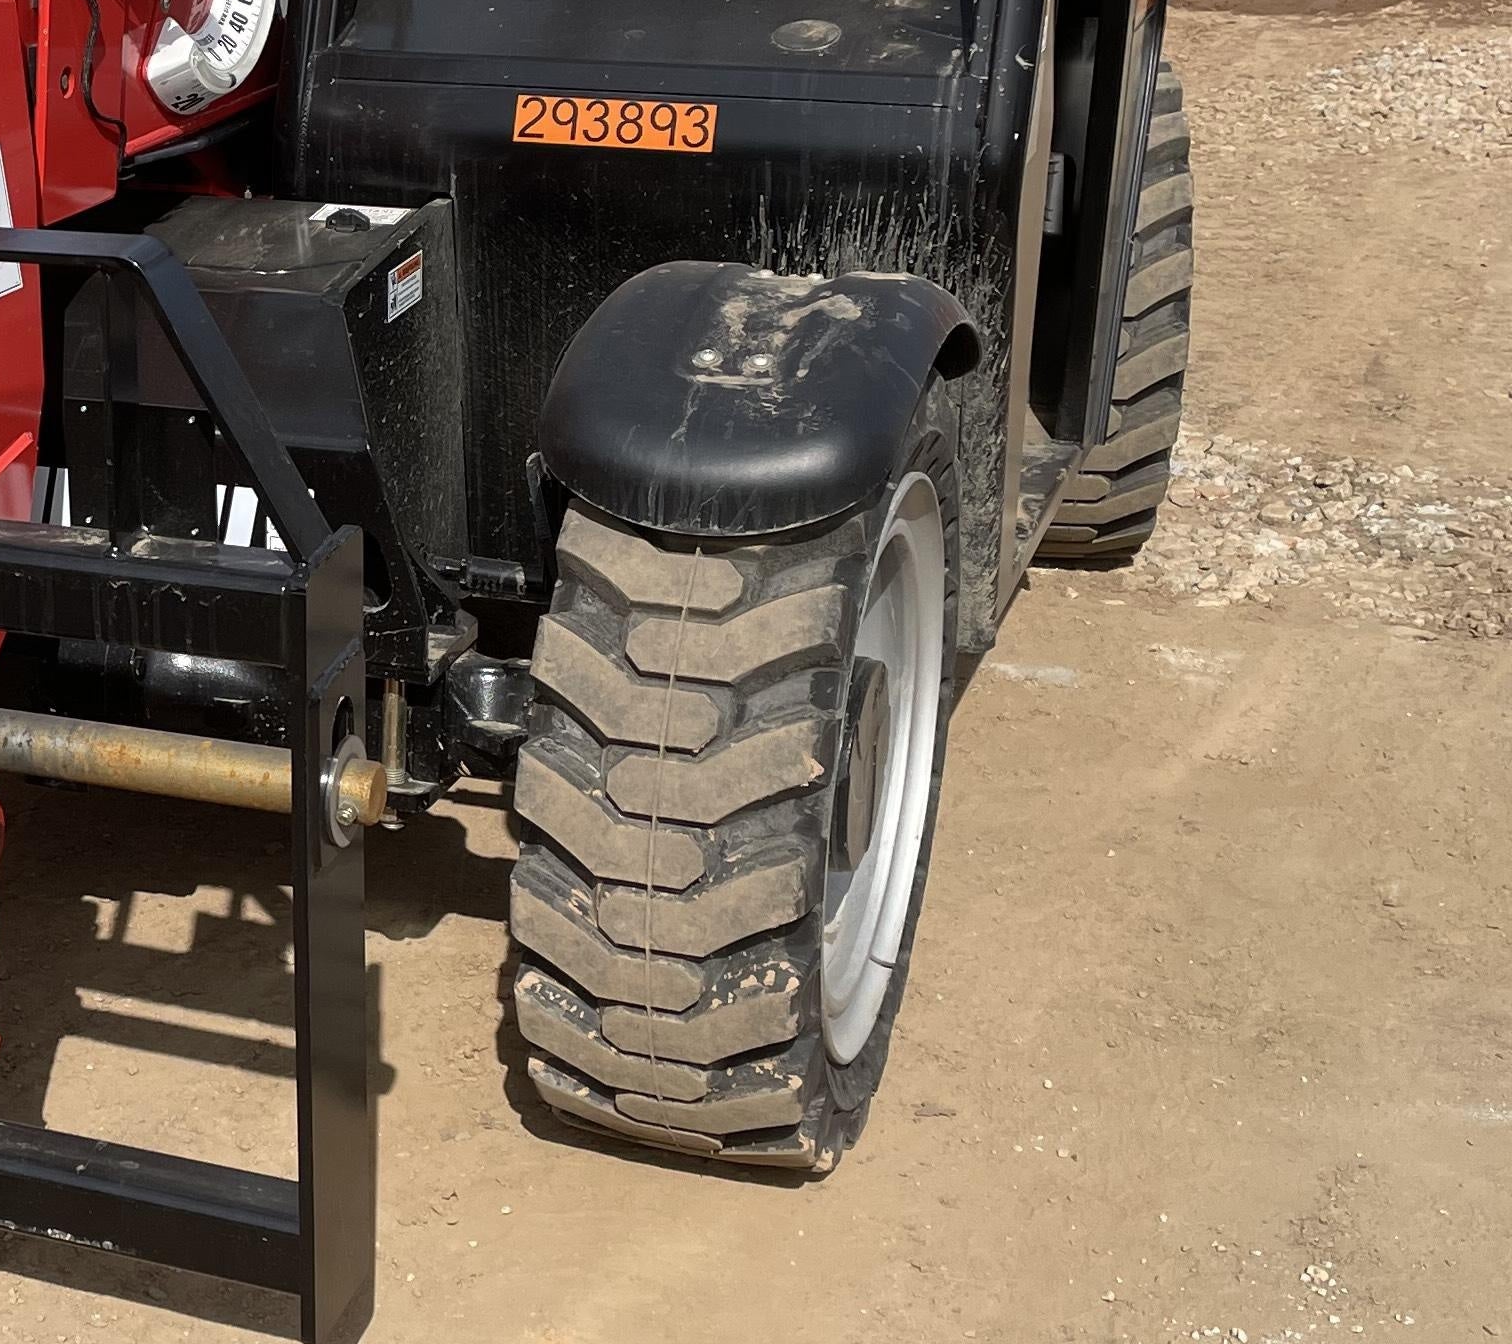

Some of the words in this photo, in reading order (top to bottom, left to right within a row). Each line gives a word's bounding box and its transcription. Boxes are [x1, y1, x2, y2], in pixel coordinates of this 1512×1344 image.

[208, 47, 222, 62] 0
[218, 34, 238, 55] 20
[231, 11, 249, 34] 40
[517, 97, 709, 148] 293893
